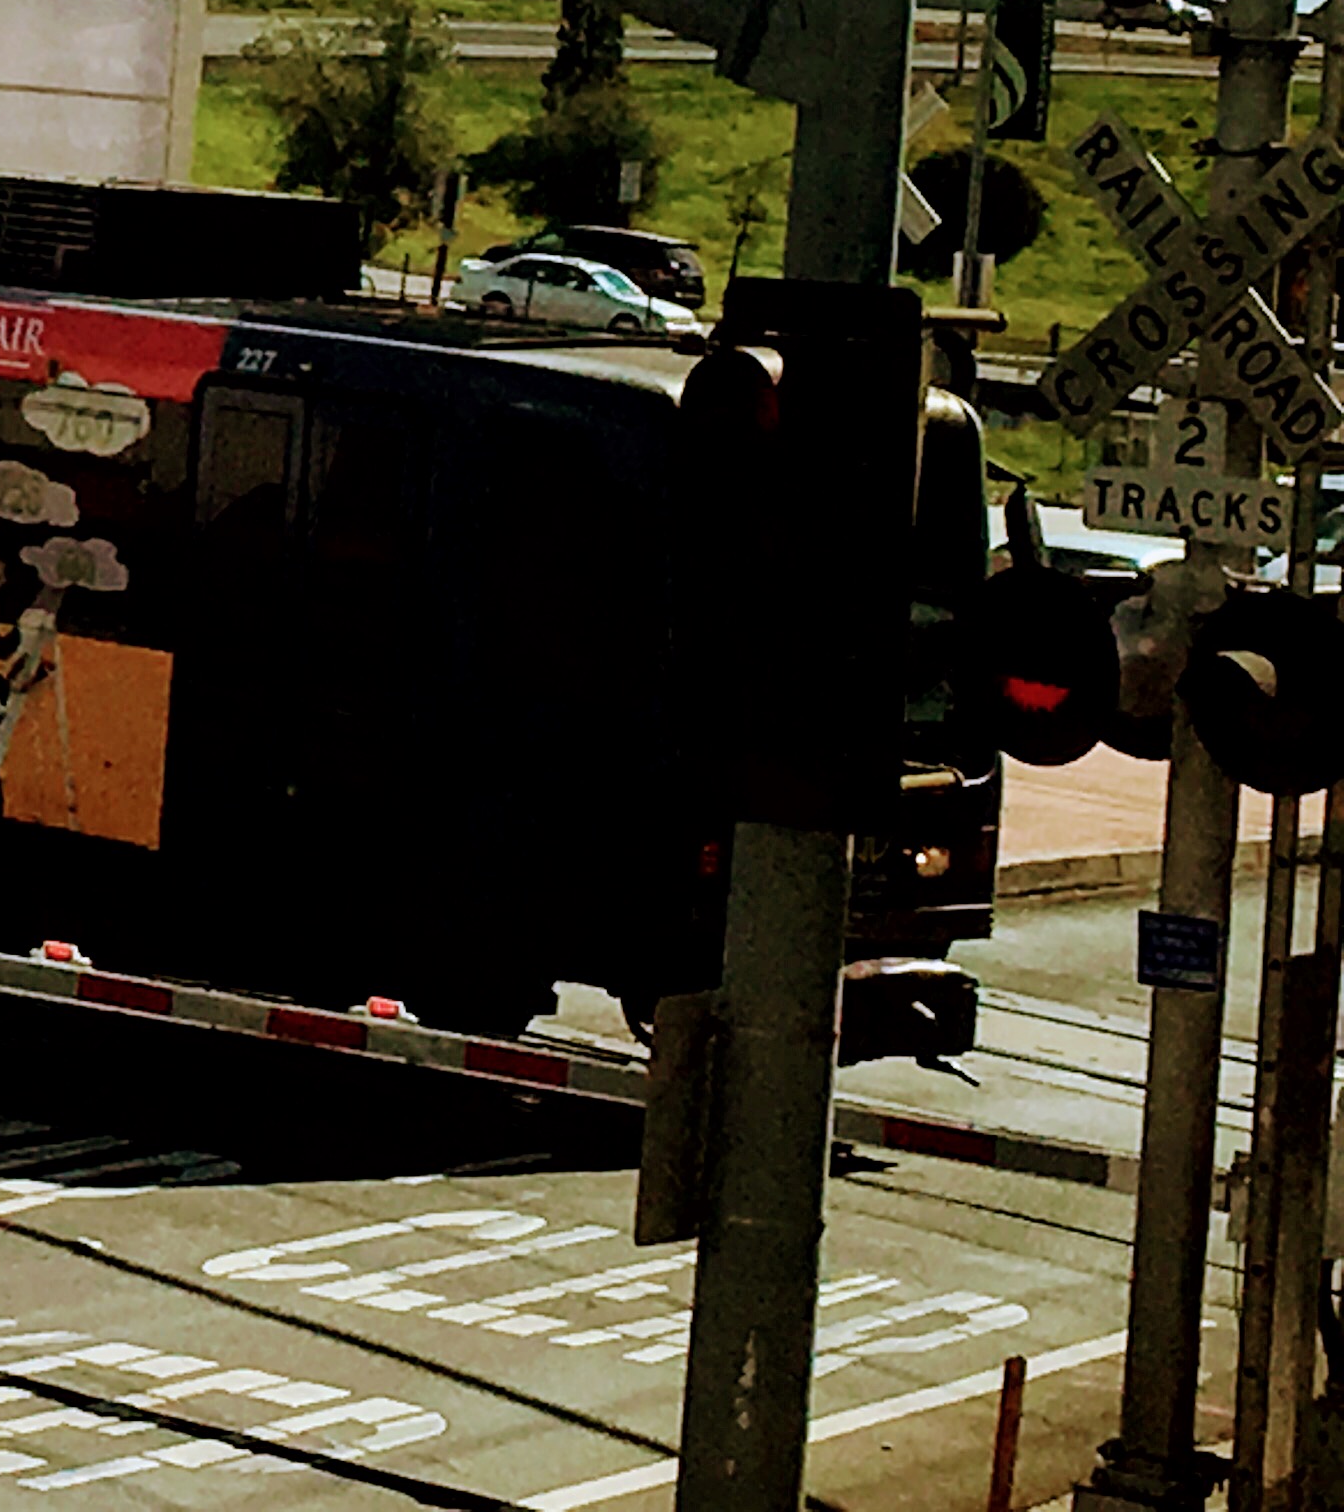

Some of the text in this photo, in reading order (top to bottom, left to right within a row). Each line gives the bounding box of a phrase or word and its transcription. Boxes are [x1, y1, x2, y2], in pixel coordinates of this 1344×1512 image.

[1053, 147, 1344, 418] CROSSING
[1073, 124, 1328, 446] RAIL ROAD
[235, 346, 279, 373] 227
[1173, 417, 1208, 468] 2
[1091, 478, 1284, 535] TRACKS
